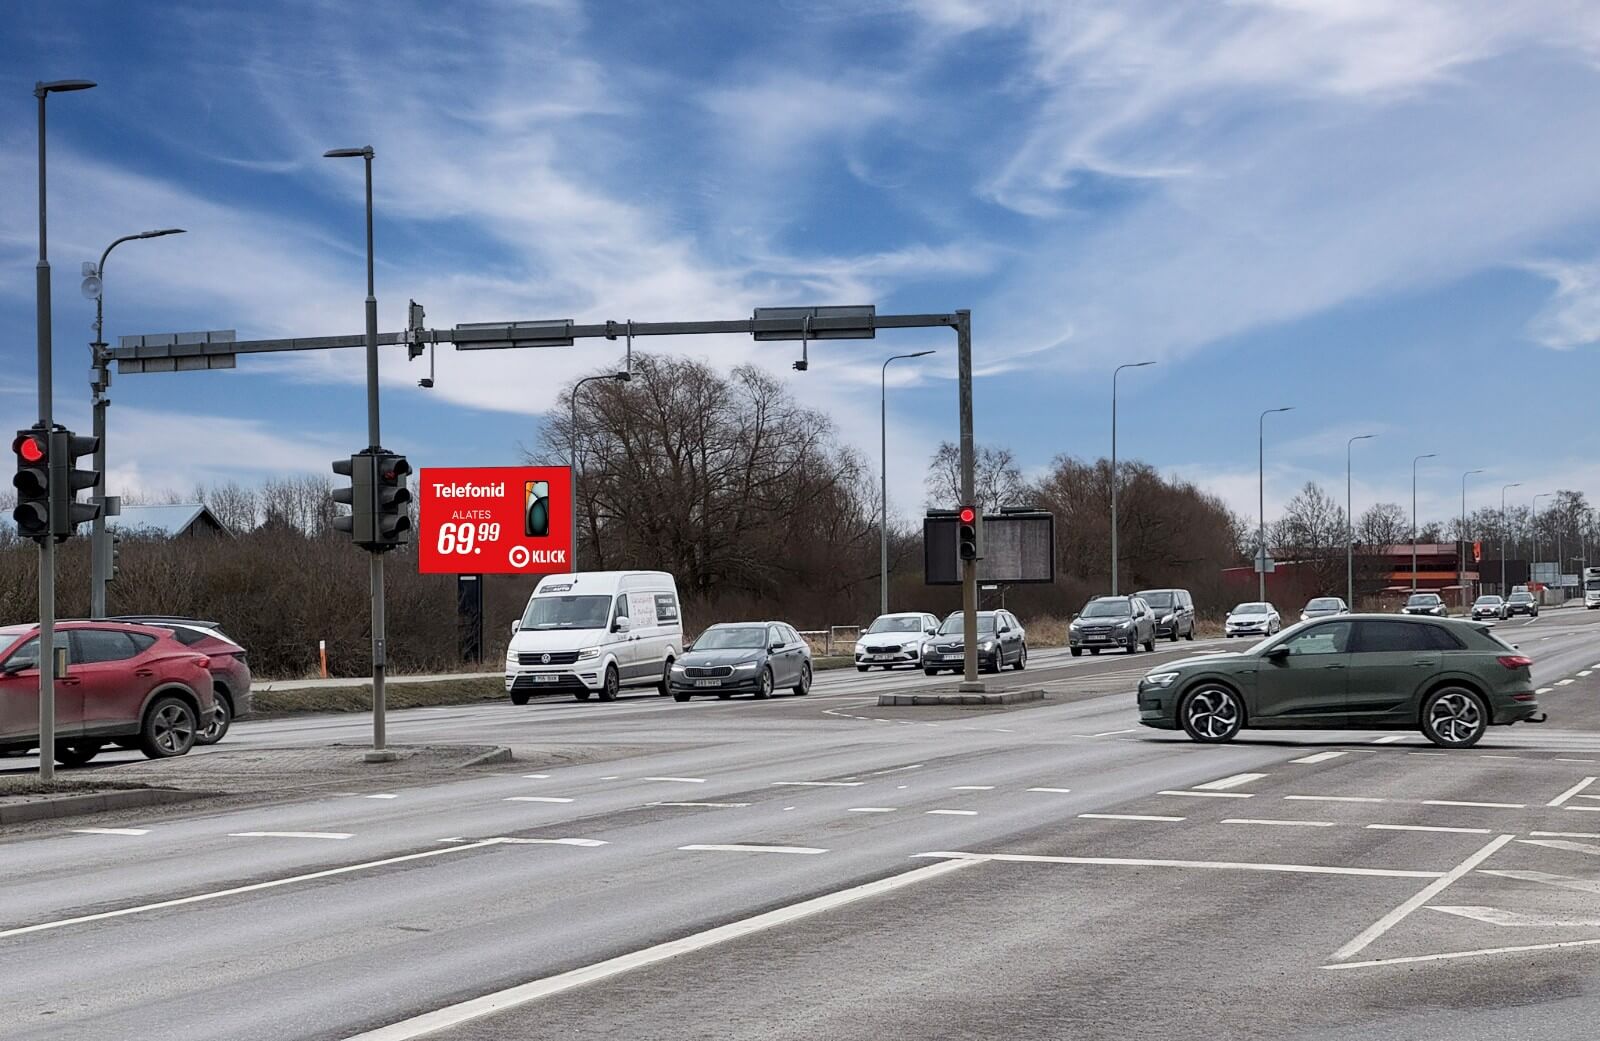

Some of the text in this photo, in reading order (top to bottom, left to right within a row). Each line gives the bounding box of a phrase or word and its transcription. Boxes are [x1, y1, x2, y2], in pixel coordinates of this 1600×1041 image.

[432, 482, 505, 498] Telefonid
[451, 510, 492, 520] ALATES
[532, 550, 566, 563] KLICK
